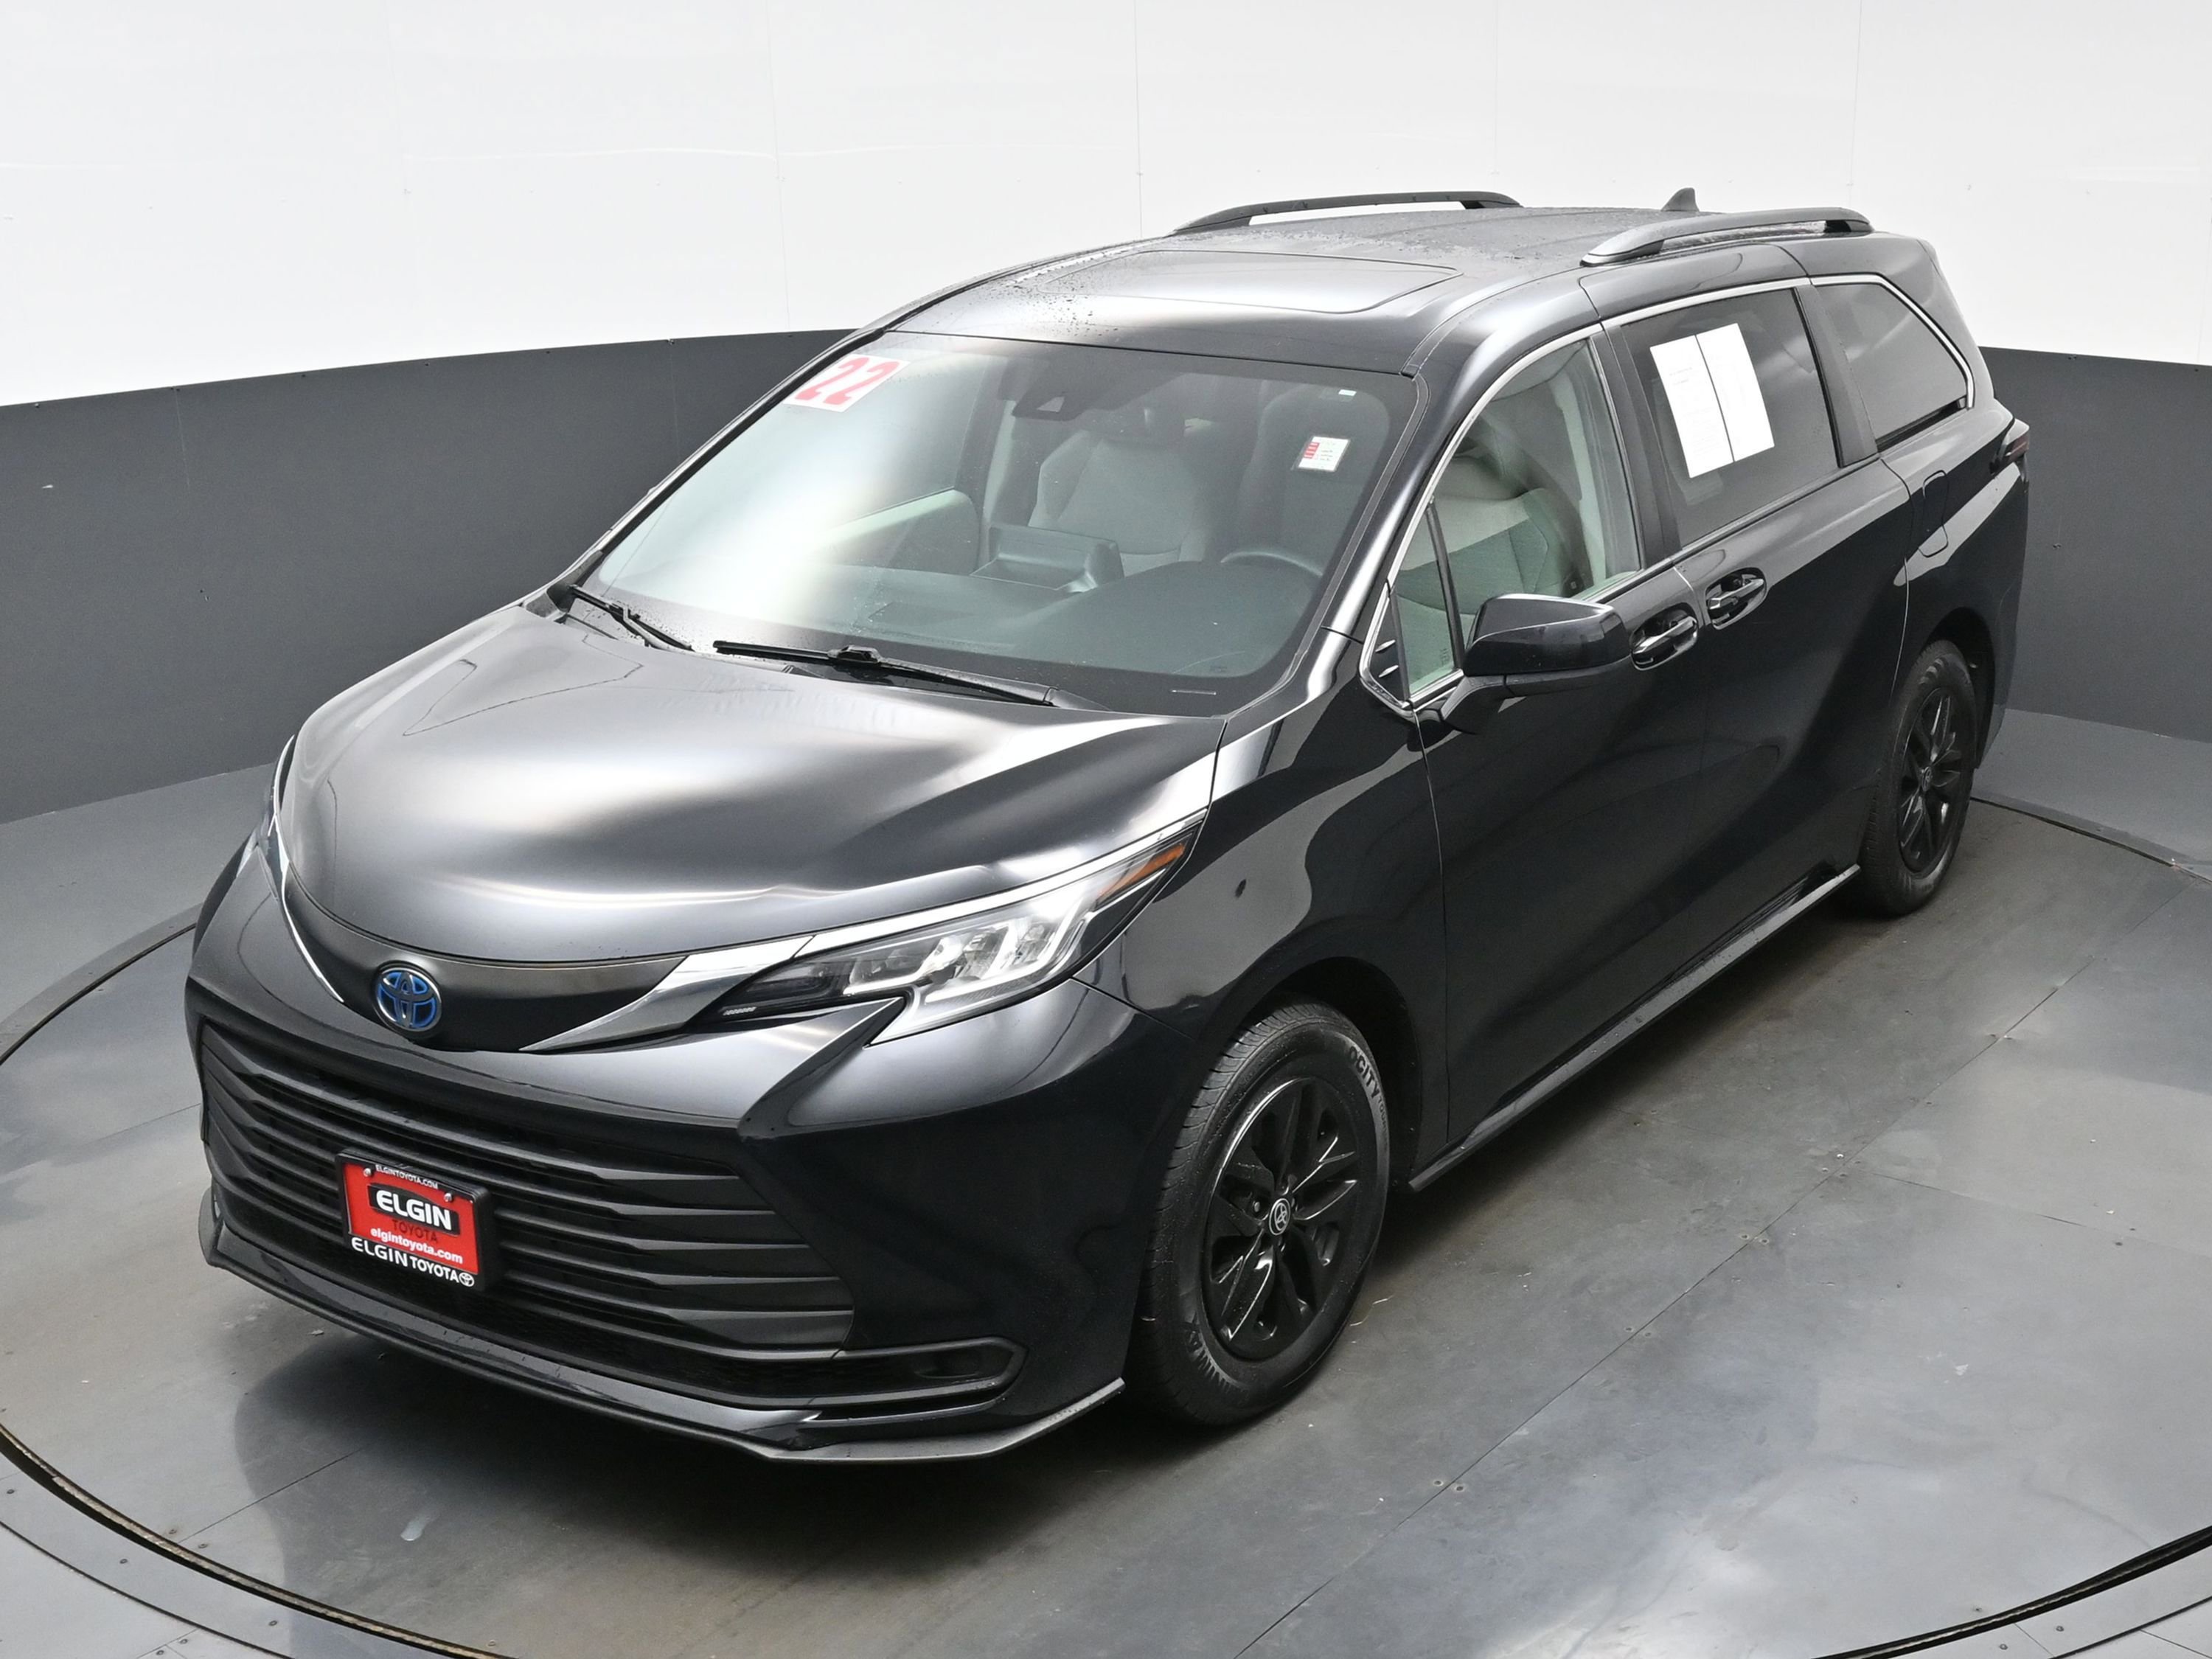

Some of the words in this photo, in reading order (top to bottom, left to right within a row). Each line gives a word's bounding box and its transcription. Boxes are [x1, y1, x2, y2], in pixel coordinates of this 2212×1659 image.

[794, 356, 900, 406] 22
[375, 1164, 439, 1190] ELGINTOYOTA.COM
[375, 1189, 453, 1231] ELGIN
[370, 1228, 464, 1265] elgintoyota.com
[392, 1219, 439, 1244] TOYOTA
[351, 1237, 408, 1267] ELGIN
[409, 1256, 460, 1284] TOYOTA
